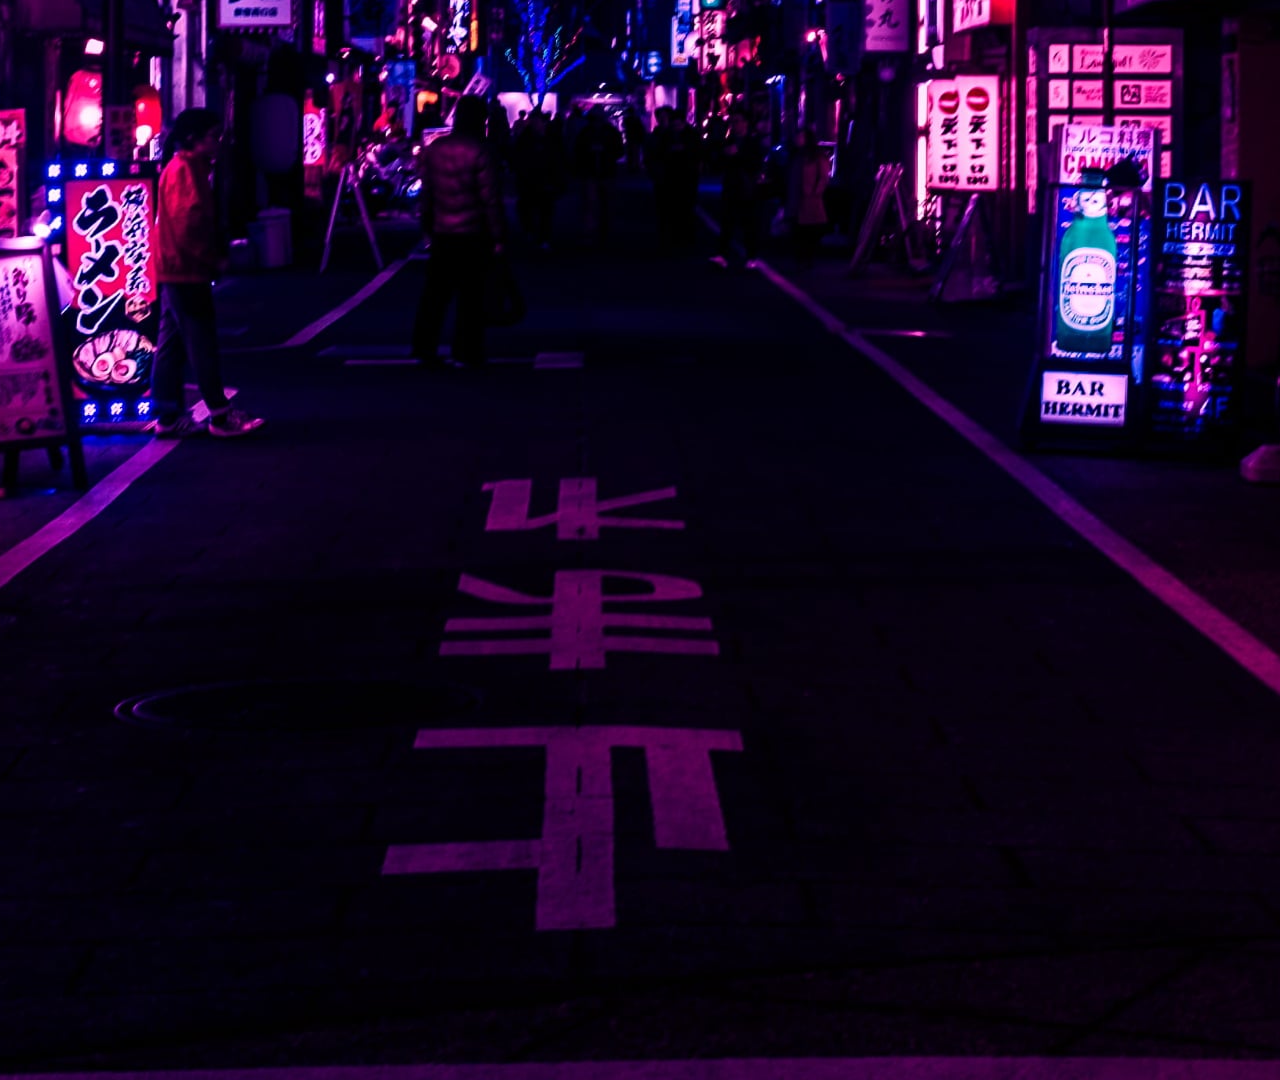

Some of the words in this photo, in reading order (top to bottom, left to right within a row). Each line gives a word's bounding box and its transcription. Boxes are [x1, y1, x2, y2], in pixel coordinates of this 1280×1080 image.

[1163, 181, 1244, 221] BAR
[1165, 221, 1239, 242] HERMIT
[1056, 379, 1106, 396] BAR
[1042, 401, 1123, 419] HERMIT
